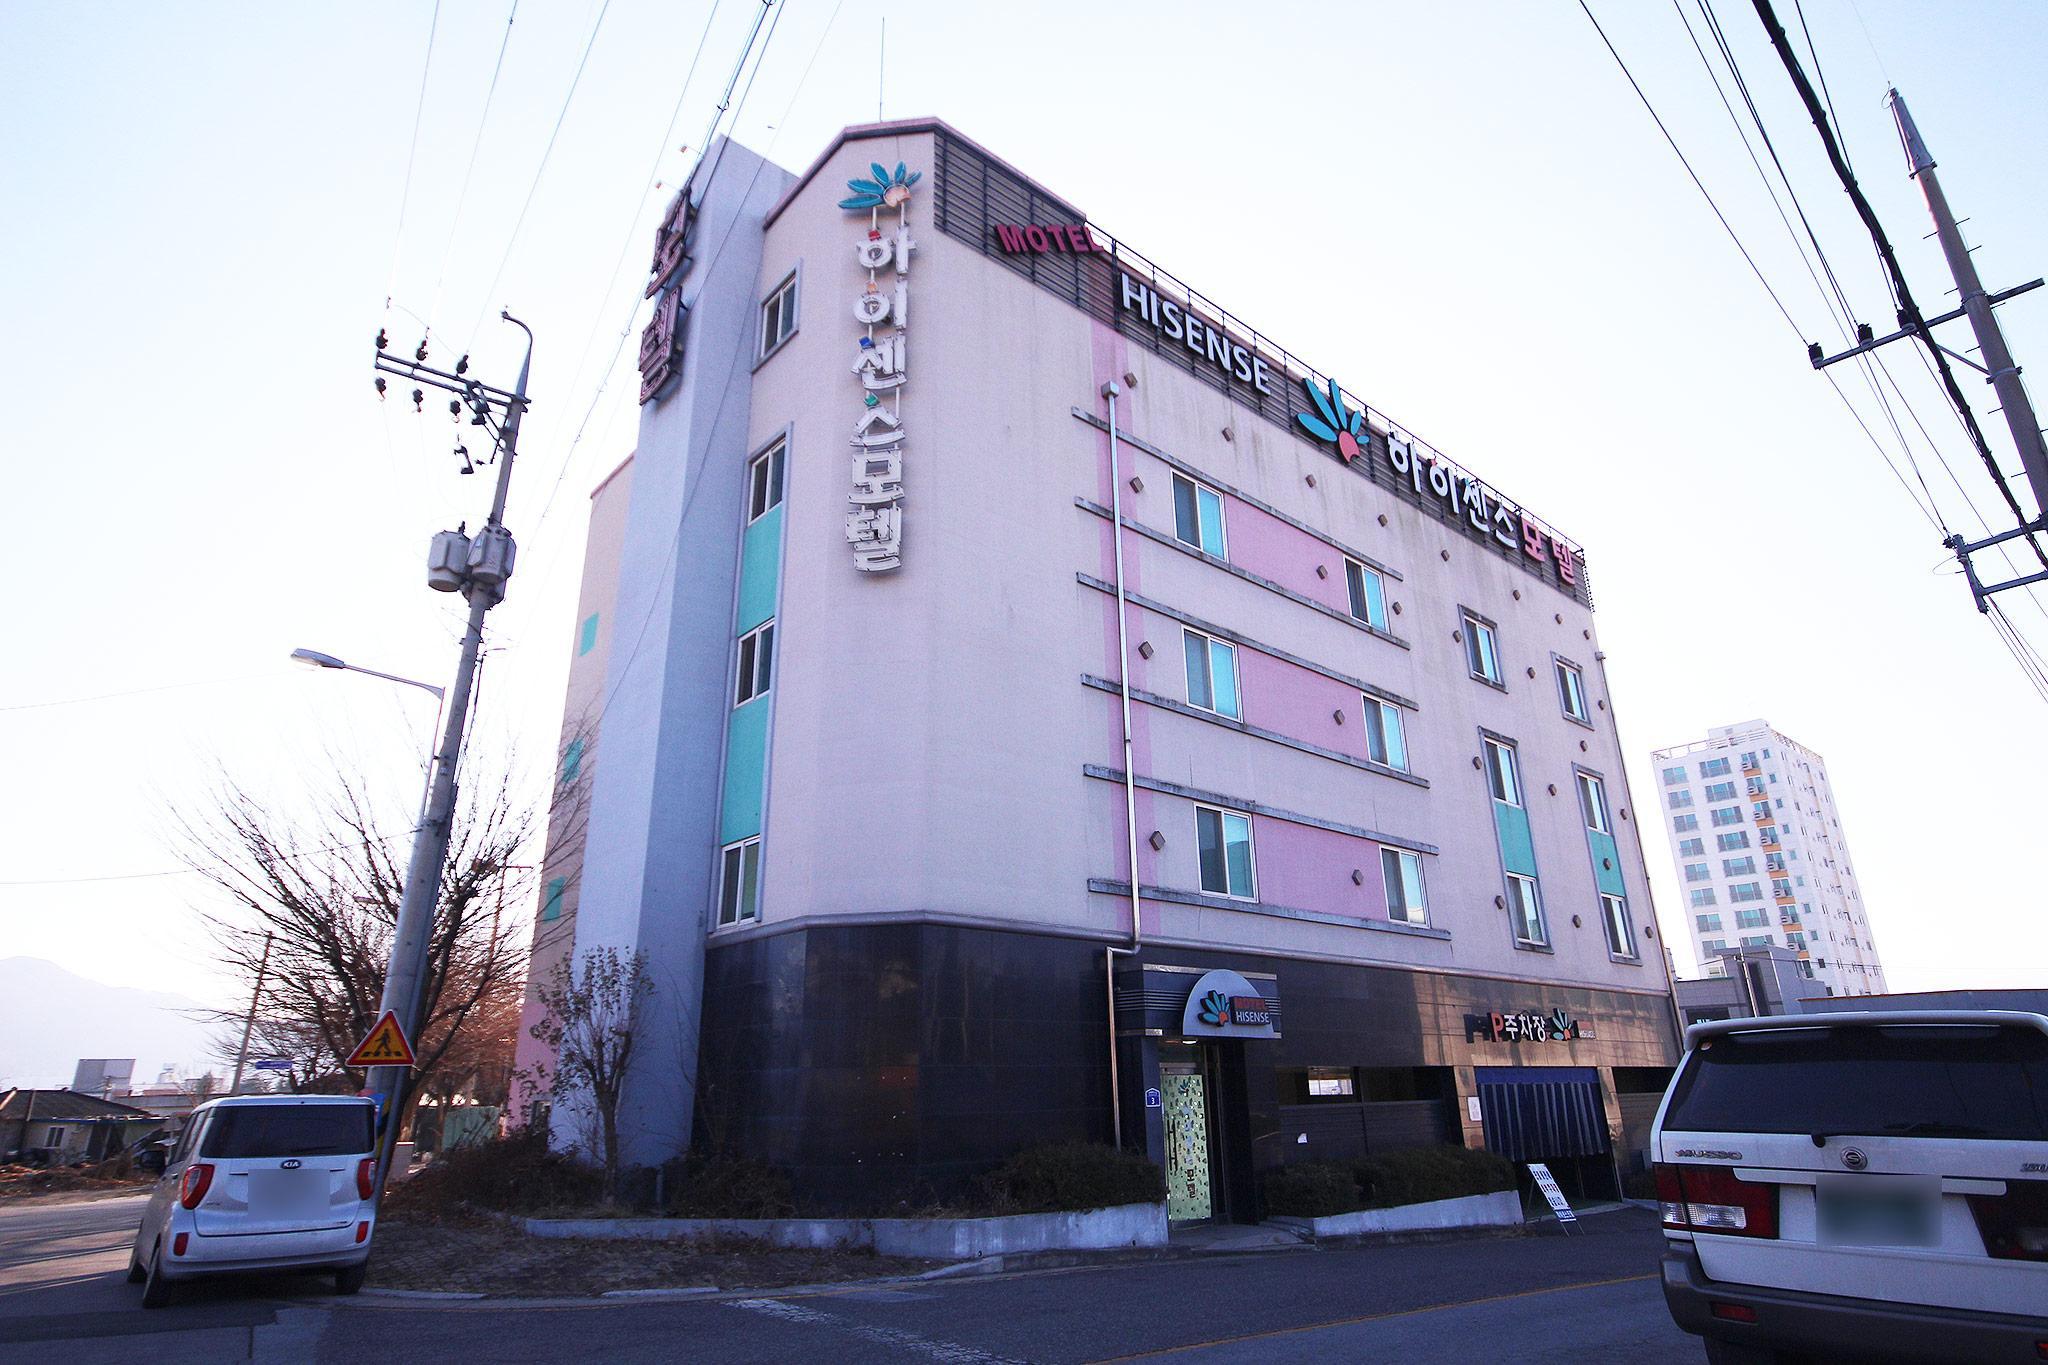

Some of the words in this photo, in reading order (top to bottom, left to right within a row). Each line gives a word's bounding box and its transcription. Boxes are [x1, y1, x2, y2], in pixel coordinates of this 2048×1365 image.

[994, 223, 1105, 253] MOTEL
[1121, 272, 1272, 397] HISENSE
[1235, 1011, 1270, 1023] HISENSE
